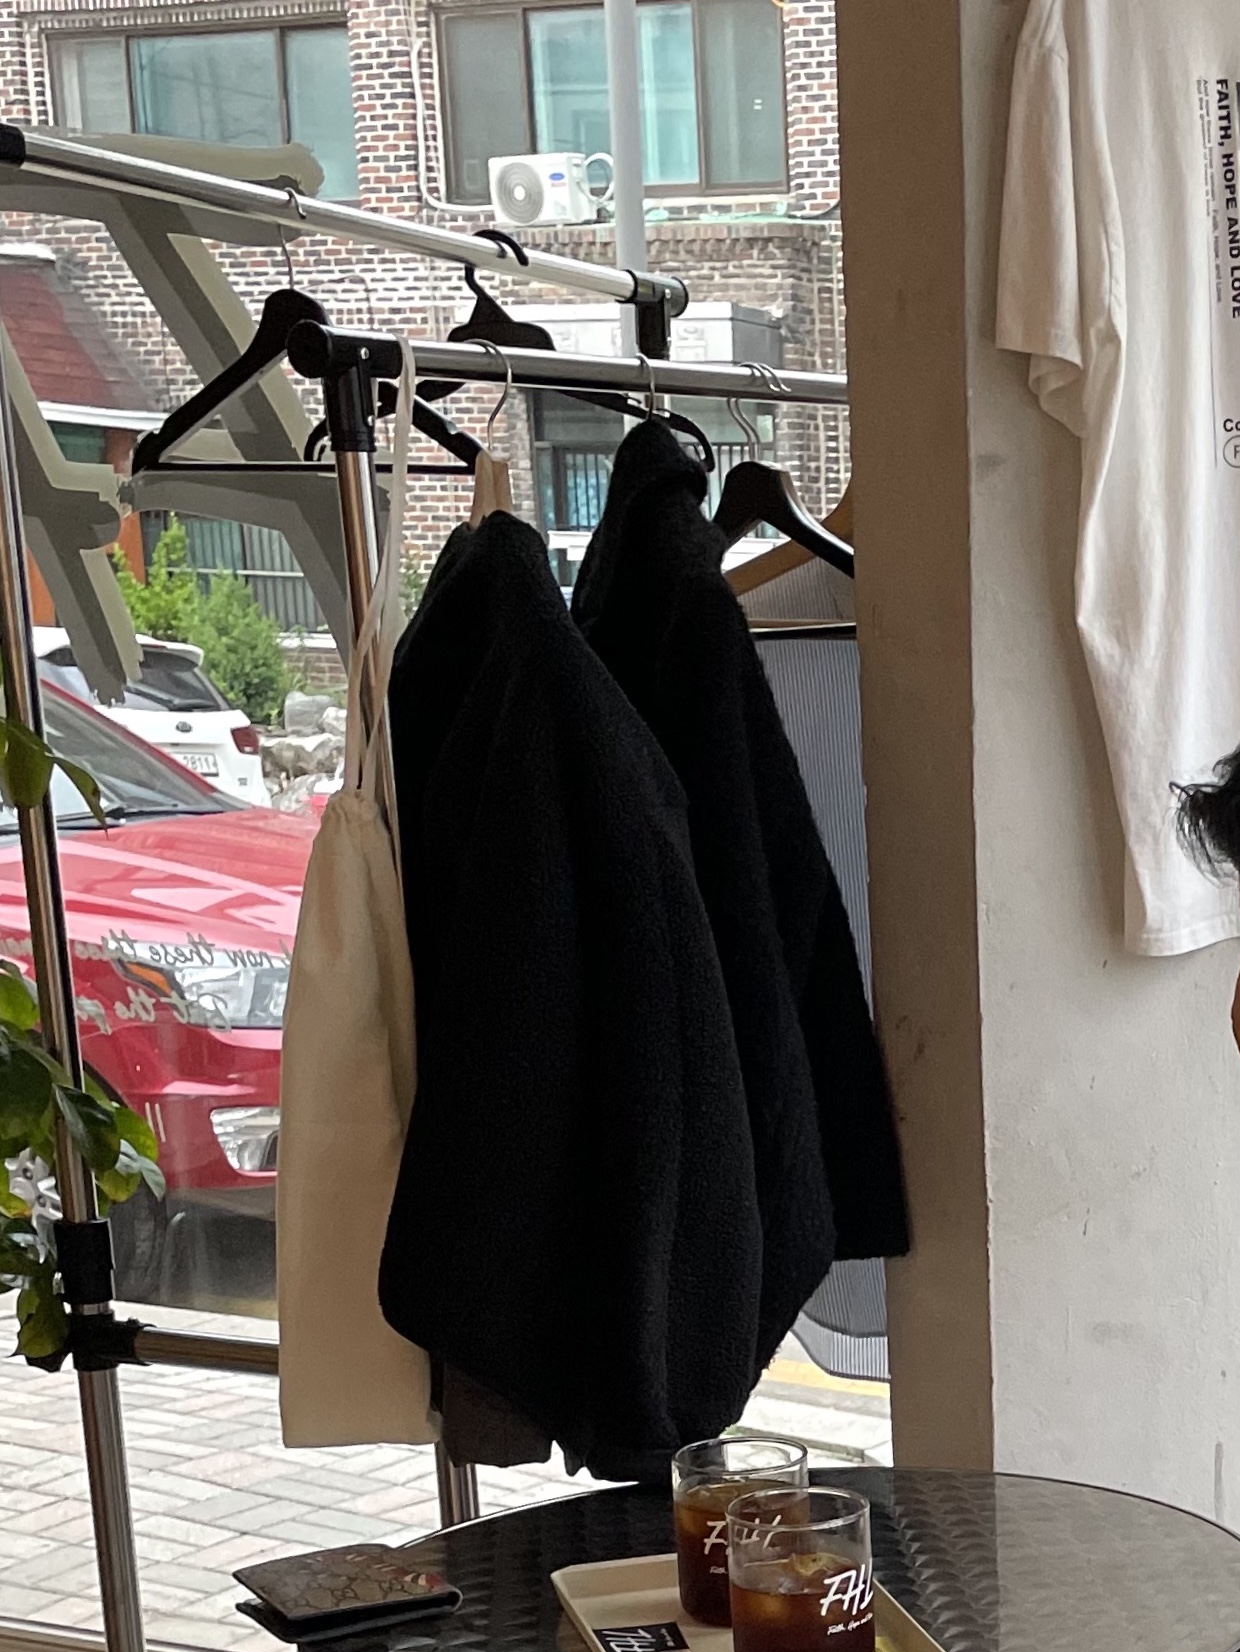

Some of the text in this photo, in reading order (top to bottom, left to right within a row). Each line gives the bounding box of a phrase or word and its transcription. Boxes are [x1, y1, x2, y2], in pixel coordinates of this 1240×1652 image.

[1216, 78, 1233, 148] FAITH,
[1222, 152, 1238, 211] HOPE
[819, 1563, 874, 1617] FHL
